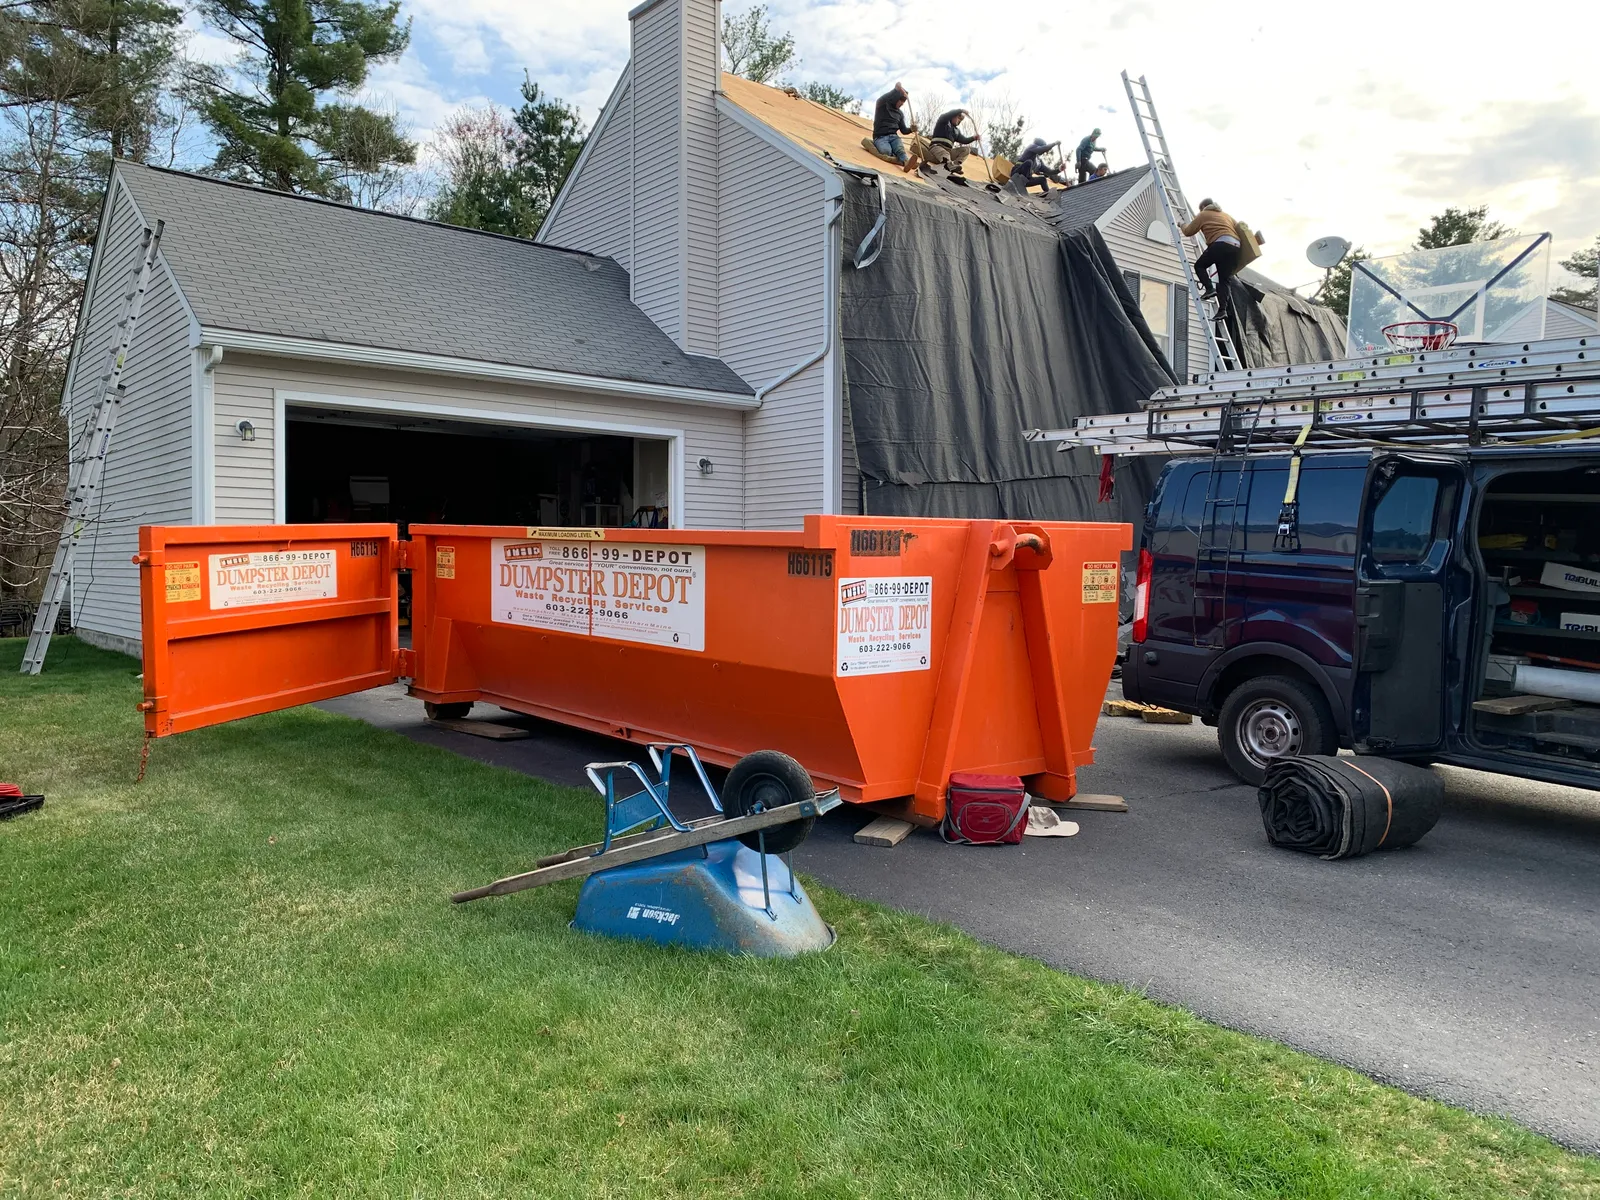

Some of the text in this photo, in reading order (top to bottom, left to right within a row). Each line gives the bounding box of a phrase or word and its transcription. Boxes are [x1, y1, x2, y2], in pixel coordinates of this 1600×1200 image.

[350, 542, 378, 557] H66115
[506, 546, 540, 557] THE
[788, 552, 832, 576] H66115
[216, 564, 331, 586] DUMPSTER DEPOT
[500, 564, 692, 604] DUMPSTER DEPOT
[844, 584, 865, 598] THE
[874, 582, 929, 595] 866-99-DEPOT
[515, 590, 668, 614] Waste Recycling Services
[546, 604, 628, 620] 603-222-9066
[840, 604, 928, 634] DUMPSTER DEPOT
[869, 634, 895, 642] Recycling
[859, 642, 911, 653] 603-222-9066
[642, 908, 680, 926] Jackson
